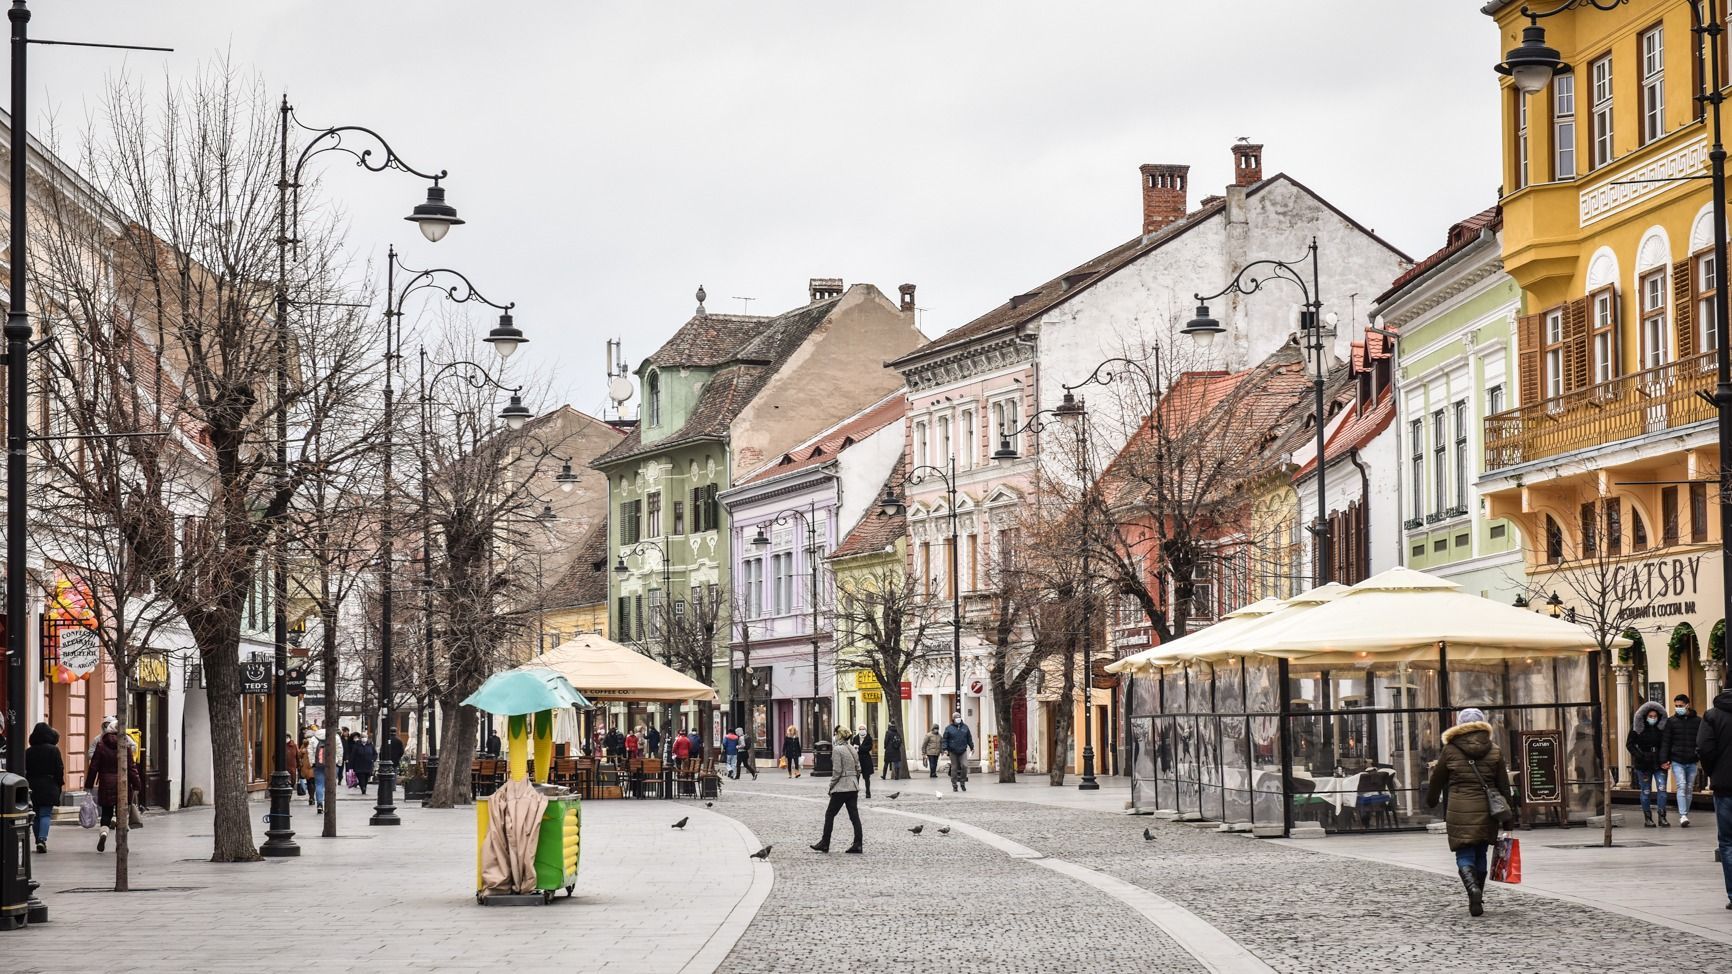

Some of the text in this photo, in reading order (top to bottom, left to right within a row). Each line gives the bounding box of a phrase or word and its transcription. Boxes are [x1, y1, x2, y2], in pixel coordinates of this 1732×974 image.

[1614, 556, 1700, 601] GATSBY
[1657, 602, 1683, 617] COCKTAIL
[1685, 601, 1696, 614] BAR
